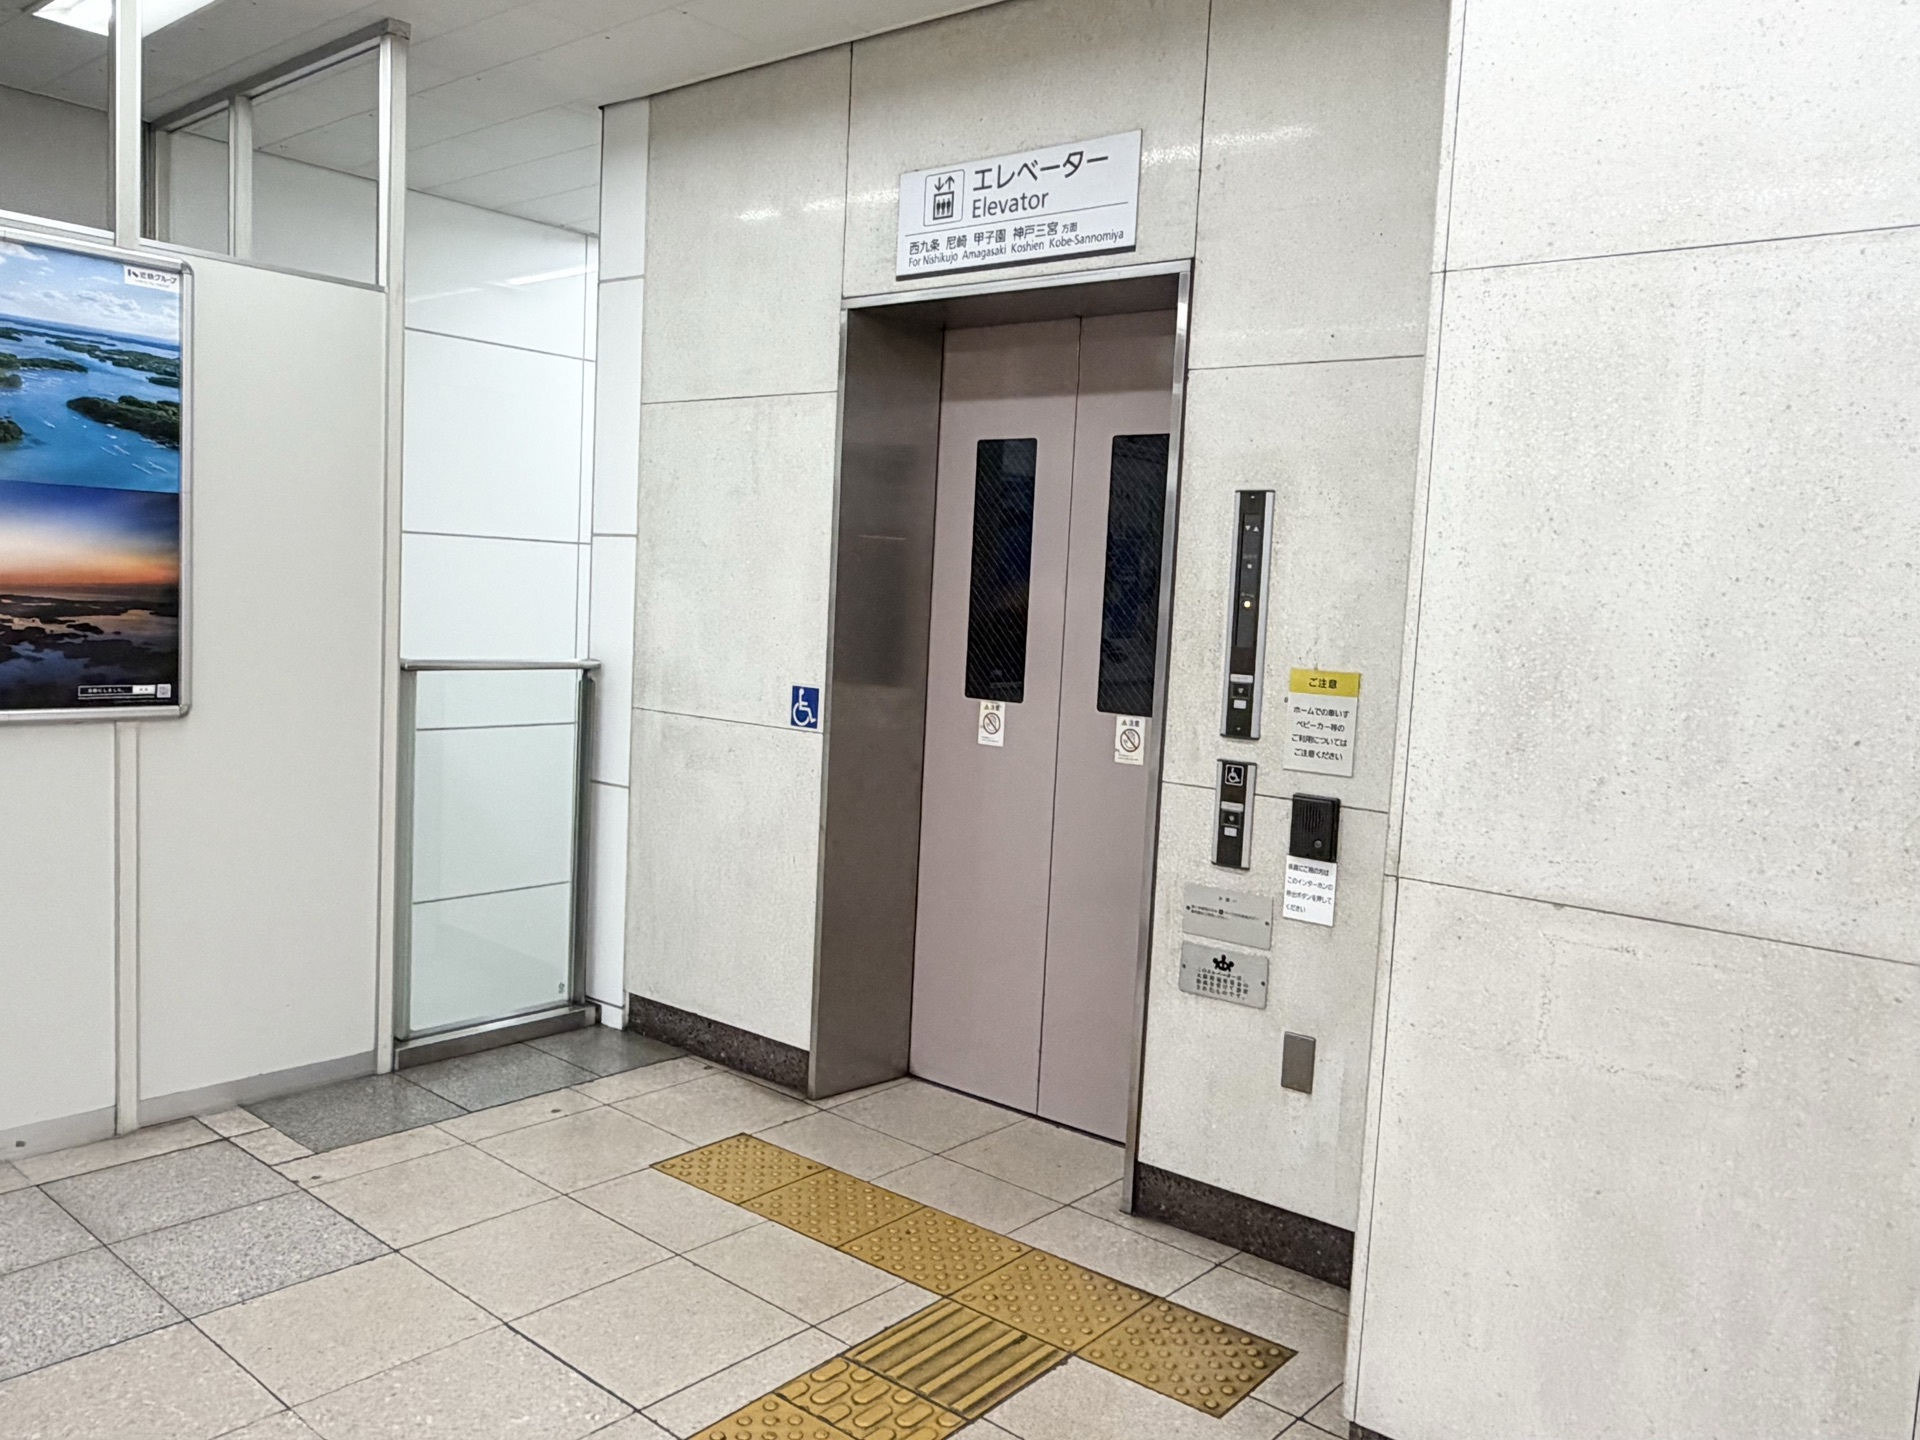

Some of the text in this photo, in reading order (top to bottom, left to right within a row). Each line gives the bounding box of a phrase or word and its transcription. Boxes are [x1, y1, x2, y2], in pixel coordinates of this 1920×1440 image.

[973, 150, 1109, 192] エレベーター
[972, 192, 1049, 219] Elevator
[908, 229, 1124, 268] For Nishikujo Amagasaki Koshien Kobe-Sannomiya
[909, 221, 1078, 255] 西九条 尼崎 甲子園 神戸三宮 方面
[1308, 677, 1338, 689] ご注意
[1293, 748, 1343, 761] ご注意ください
[1286, 903, 1306, 913] ください
